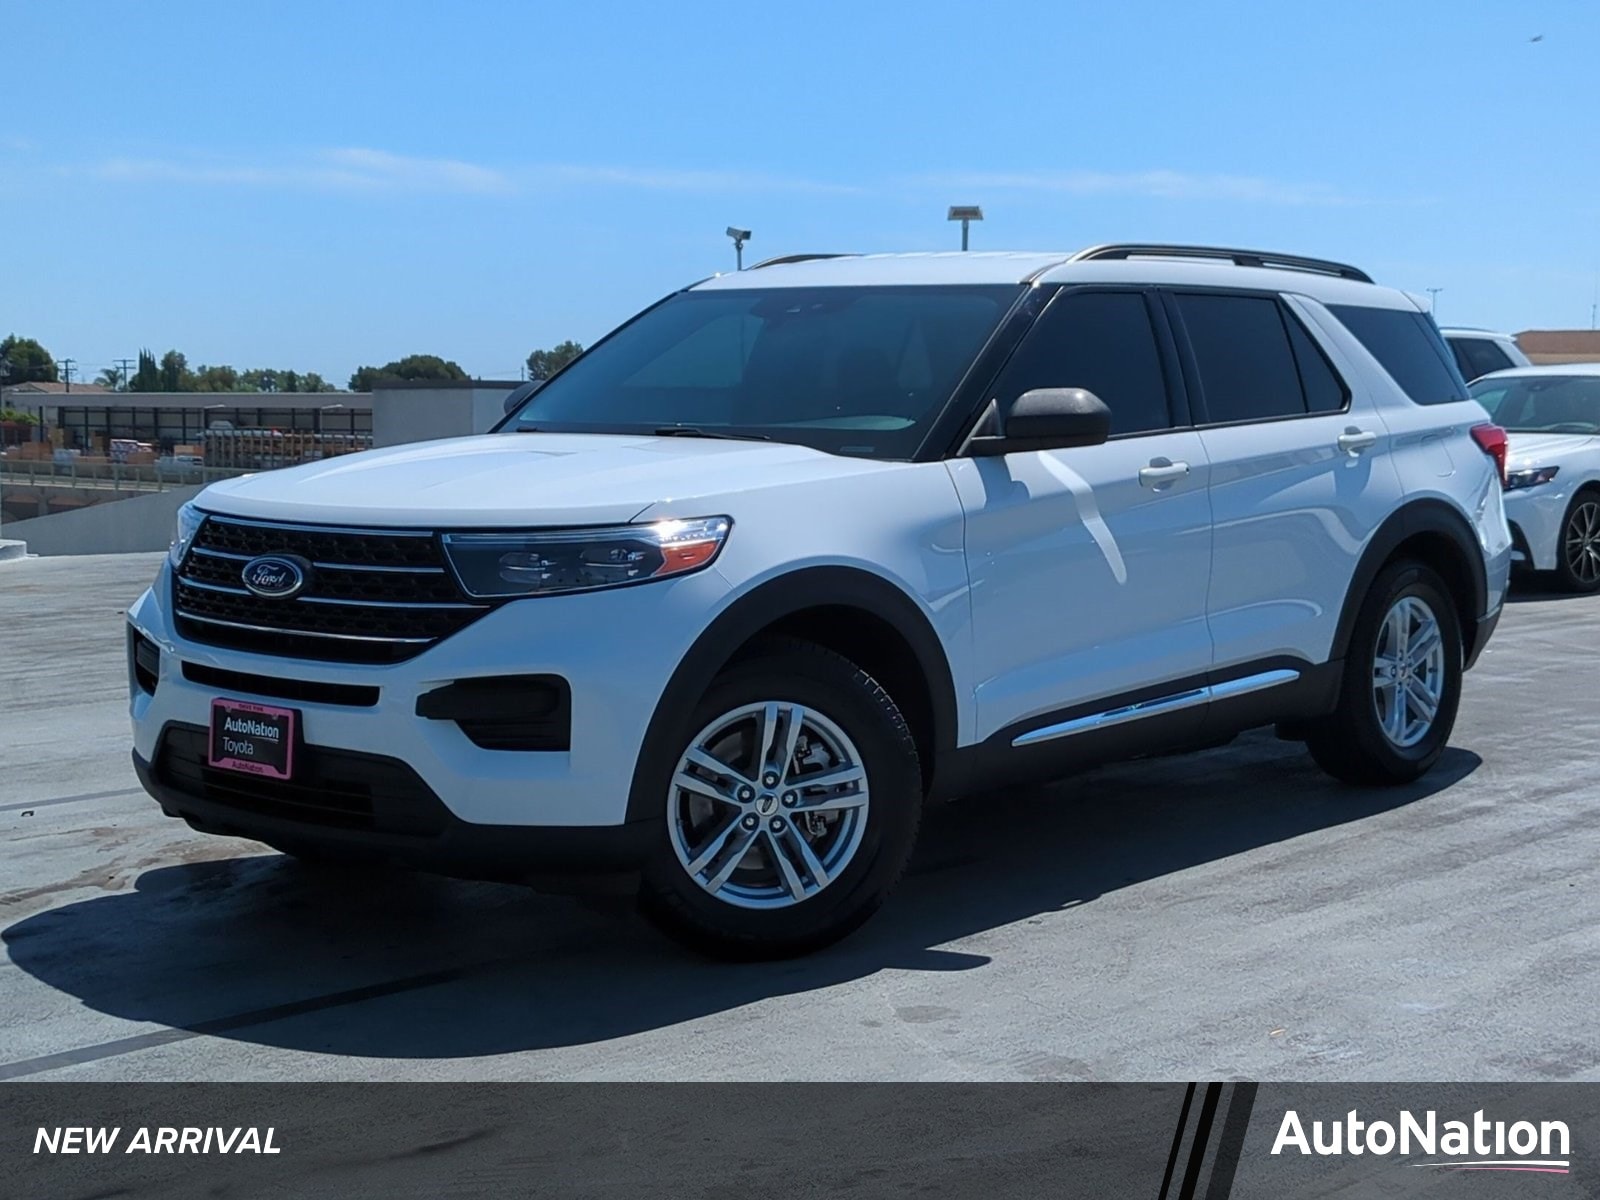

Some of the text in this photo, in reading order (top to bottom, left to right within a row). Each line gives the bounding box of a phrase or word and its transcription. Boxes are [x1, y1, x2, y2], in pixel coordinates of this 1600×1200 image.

[252, 564, 287, 586] Ford
[224, 717, 279, 739] AutoNation
[222, 736, 254, 755] Toyota
